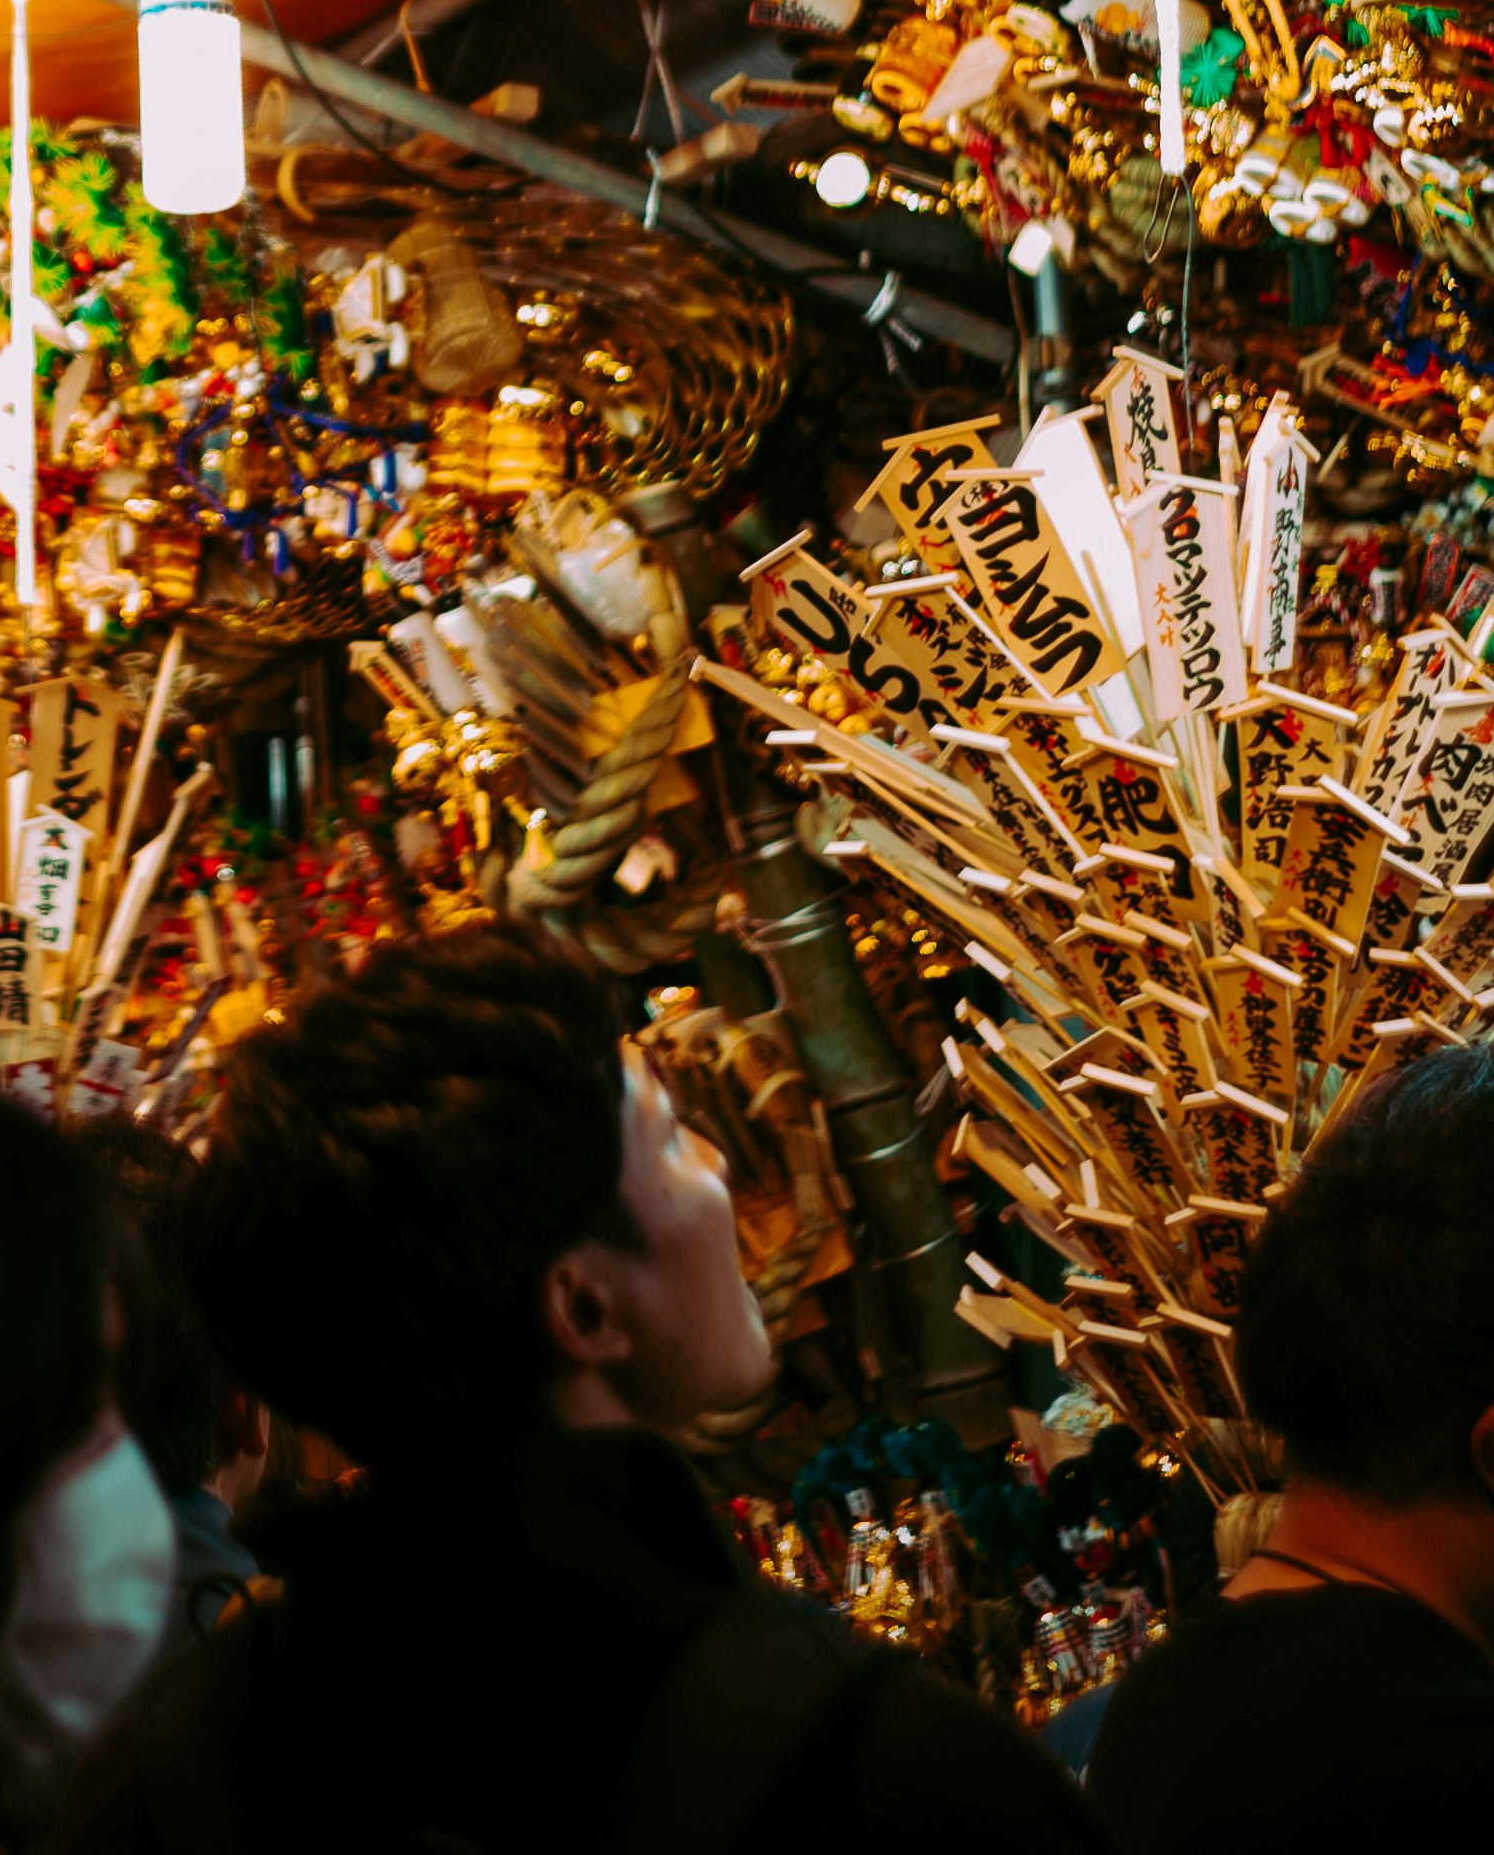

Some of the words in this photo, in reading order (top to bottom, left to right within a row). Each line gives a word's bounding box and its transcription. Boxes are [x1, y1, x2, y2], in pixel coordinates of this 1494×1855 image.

[943, 600, 1034, 696] 有限会社
[957, 484, 1105, 698] ヨシムラ
[1158, 489, 1226, 711] クロマツテツロウ
